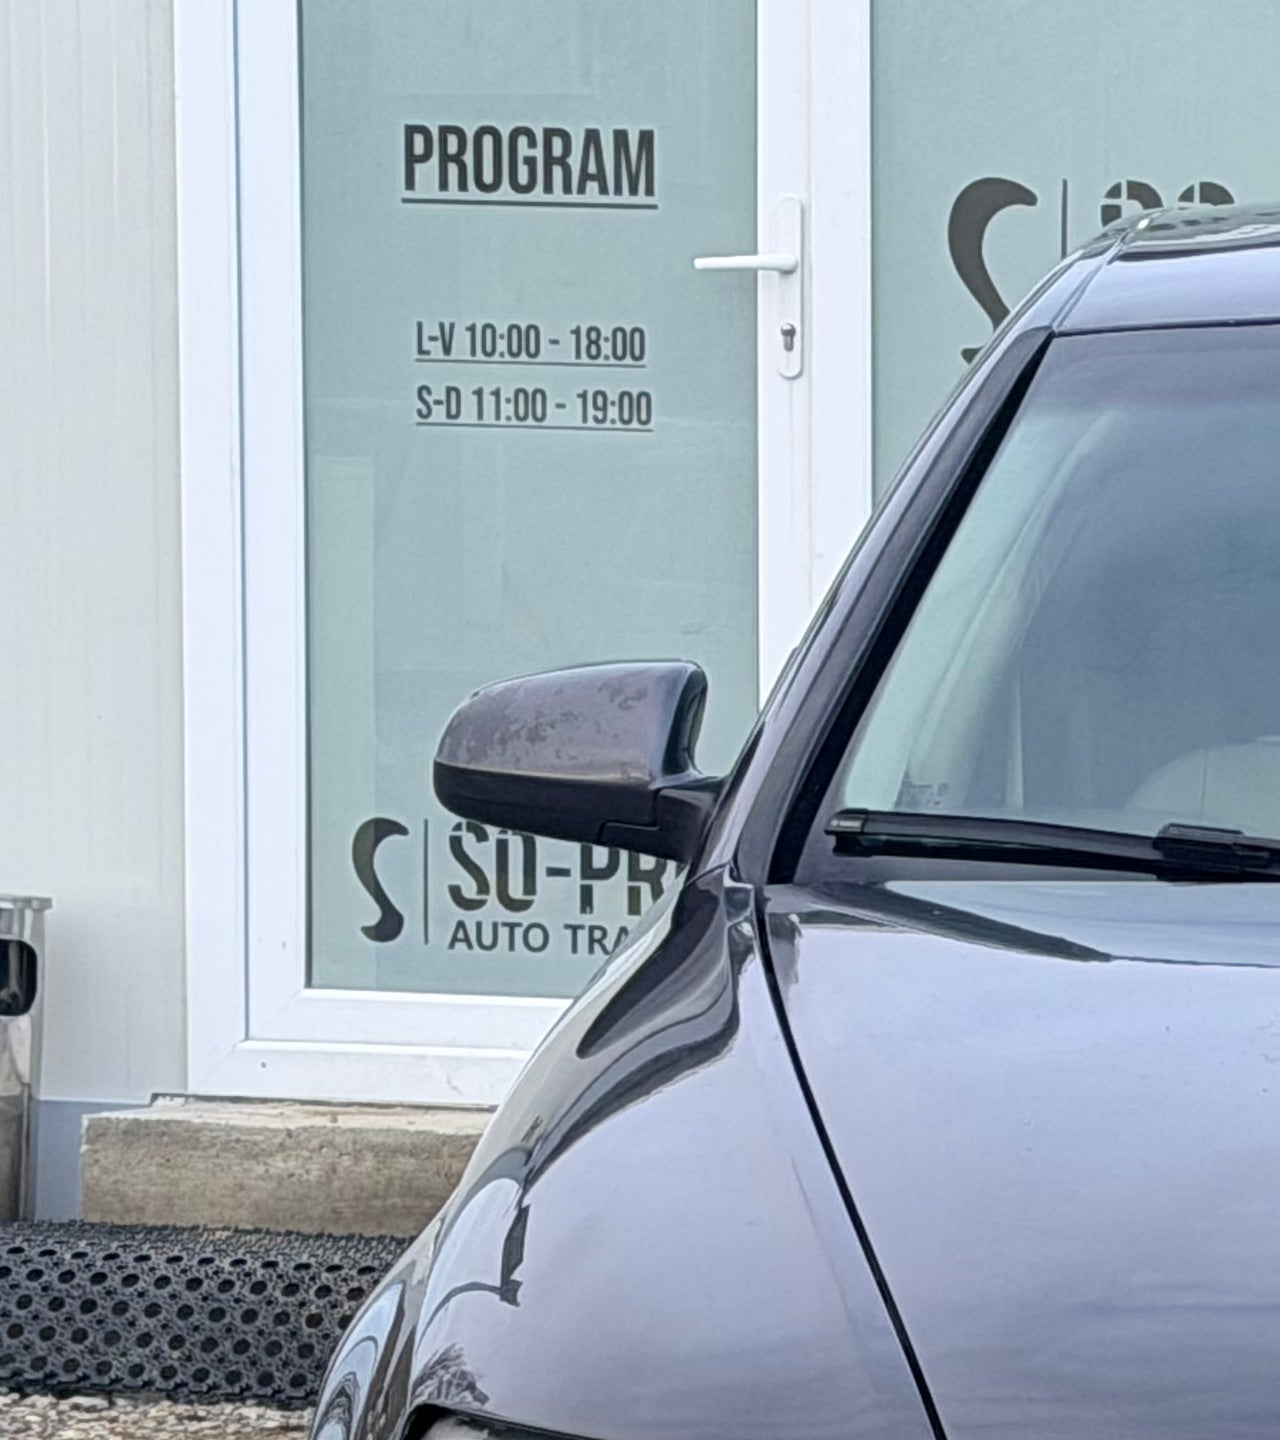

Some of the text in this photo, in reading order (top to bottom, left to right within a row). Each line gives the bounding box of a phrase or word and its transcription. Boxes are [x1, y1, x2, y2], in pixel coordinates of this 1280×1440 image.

[404, 123, 655, 197] PROGRAM
[416, 320, 456, 357] L-V
[464, 322, 541, 360] 10:00
[569, 325, 646, 362] 18:00
[416, 384, 462, 420] S-D
[471, 386, 547, 423] 11:00
[576, 389, 652, 426] 19:00
[448, 819, 688, 916] SO-PR
[447, 919, 630, 956] AUTO TRA
